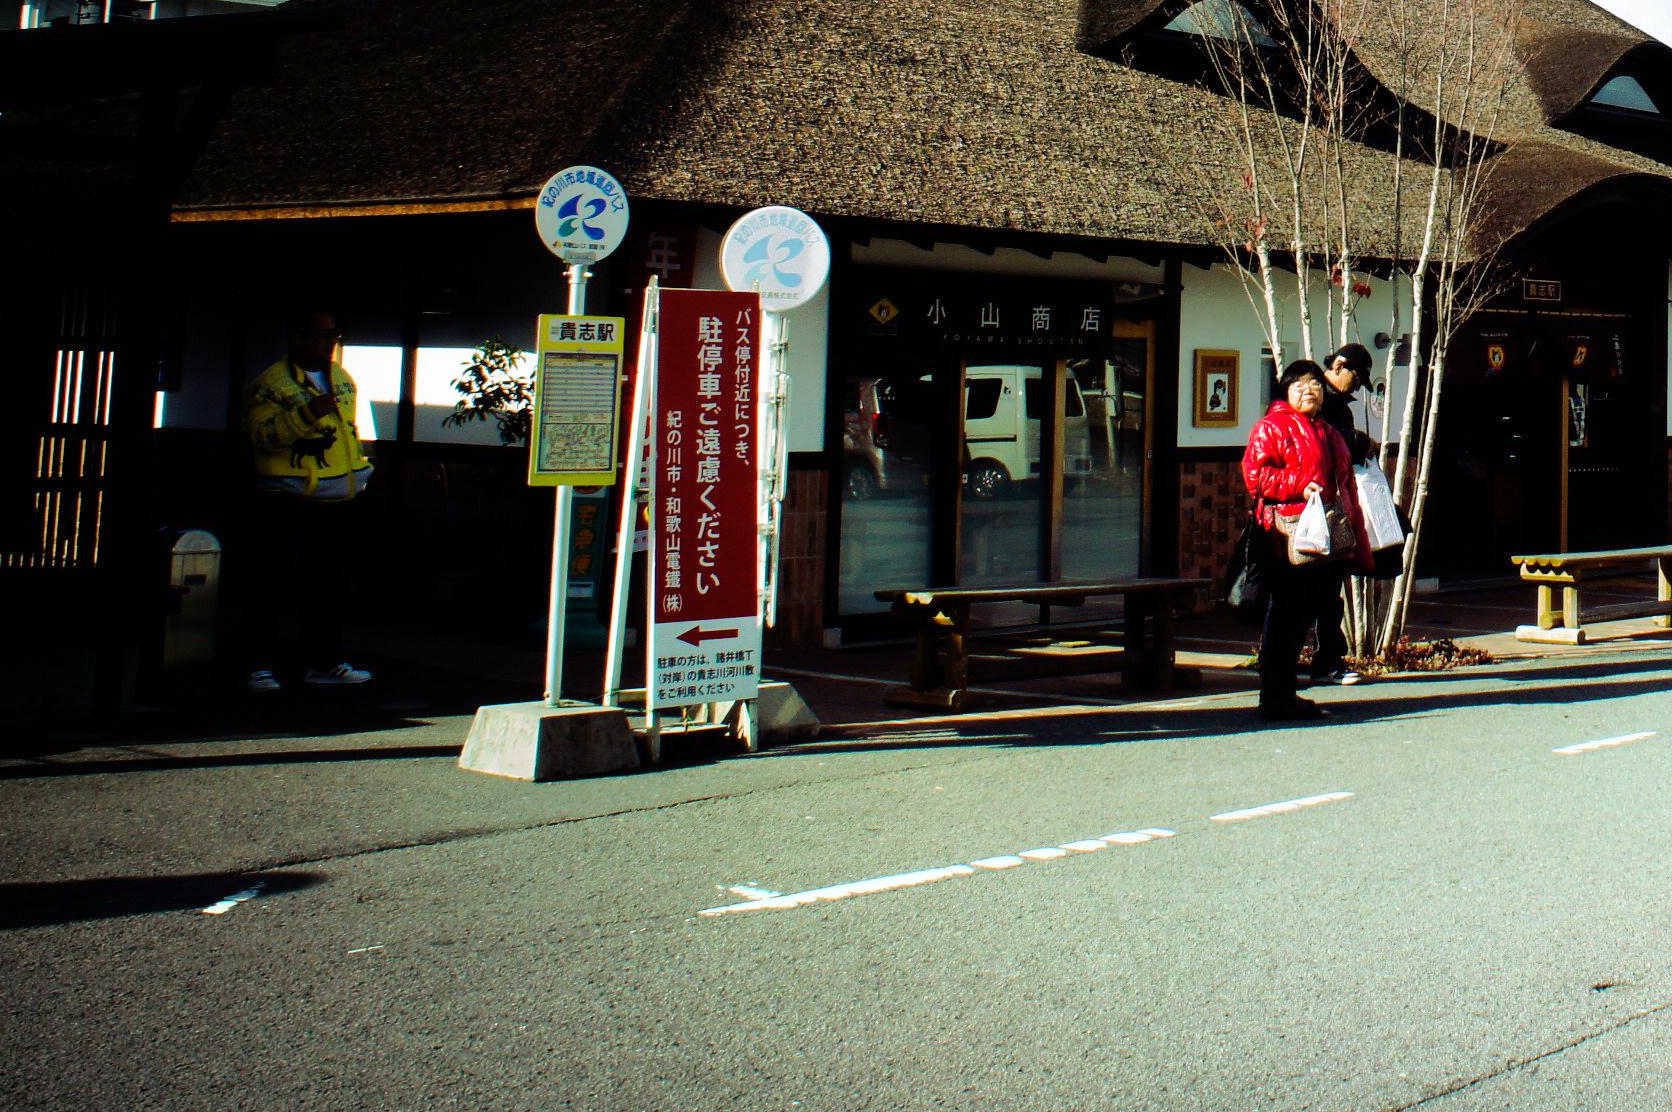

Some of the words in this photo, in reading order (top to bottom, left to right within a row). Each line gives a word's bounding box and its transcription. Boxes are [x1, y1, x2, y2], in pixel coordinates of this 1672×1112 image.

[559, 321, 614, 342] 貴志駅
[926, 297, 1101, 332] 小山商店
[734, 308, 752, 466] バス停付近につき、
[696, 316, 723, 595] 駐停車ご遠慮ください
[657, 682, 735, 700] をご利用ください
